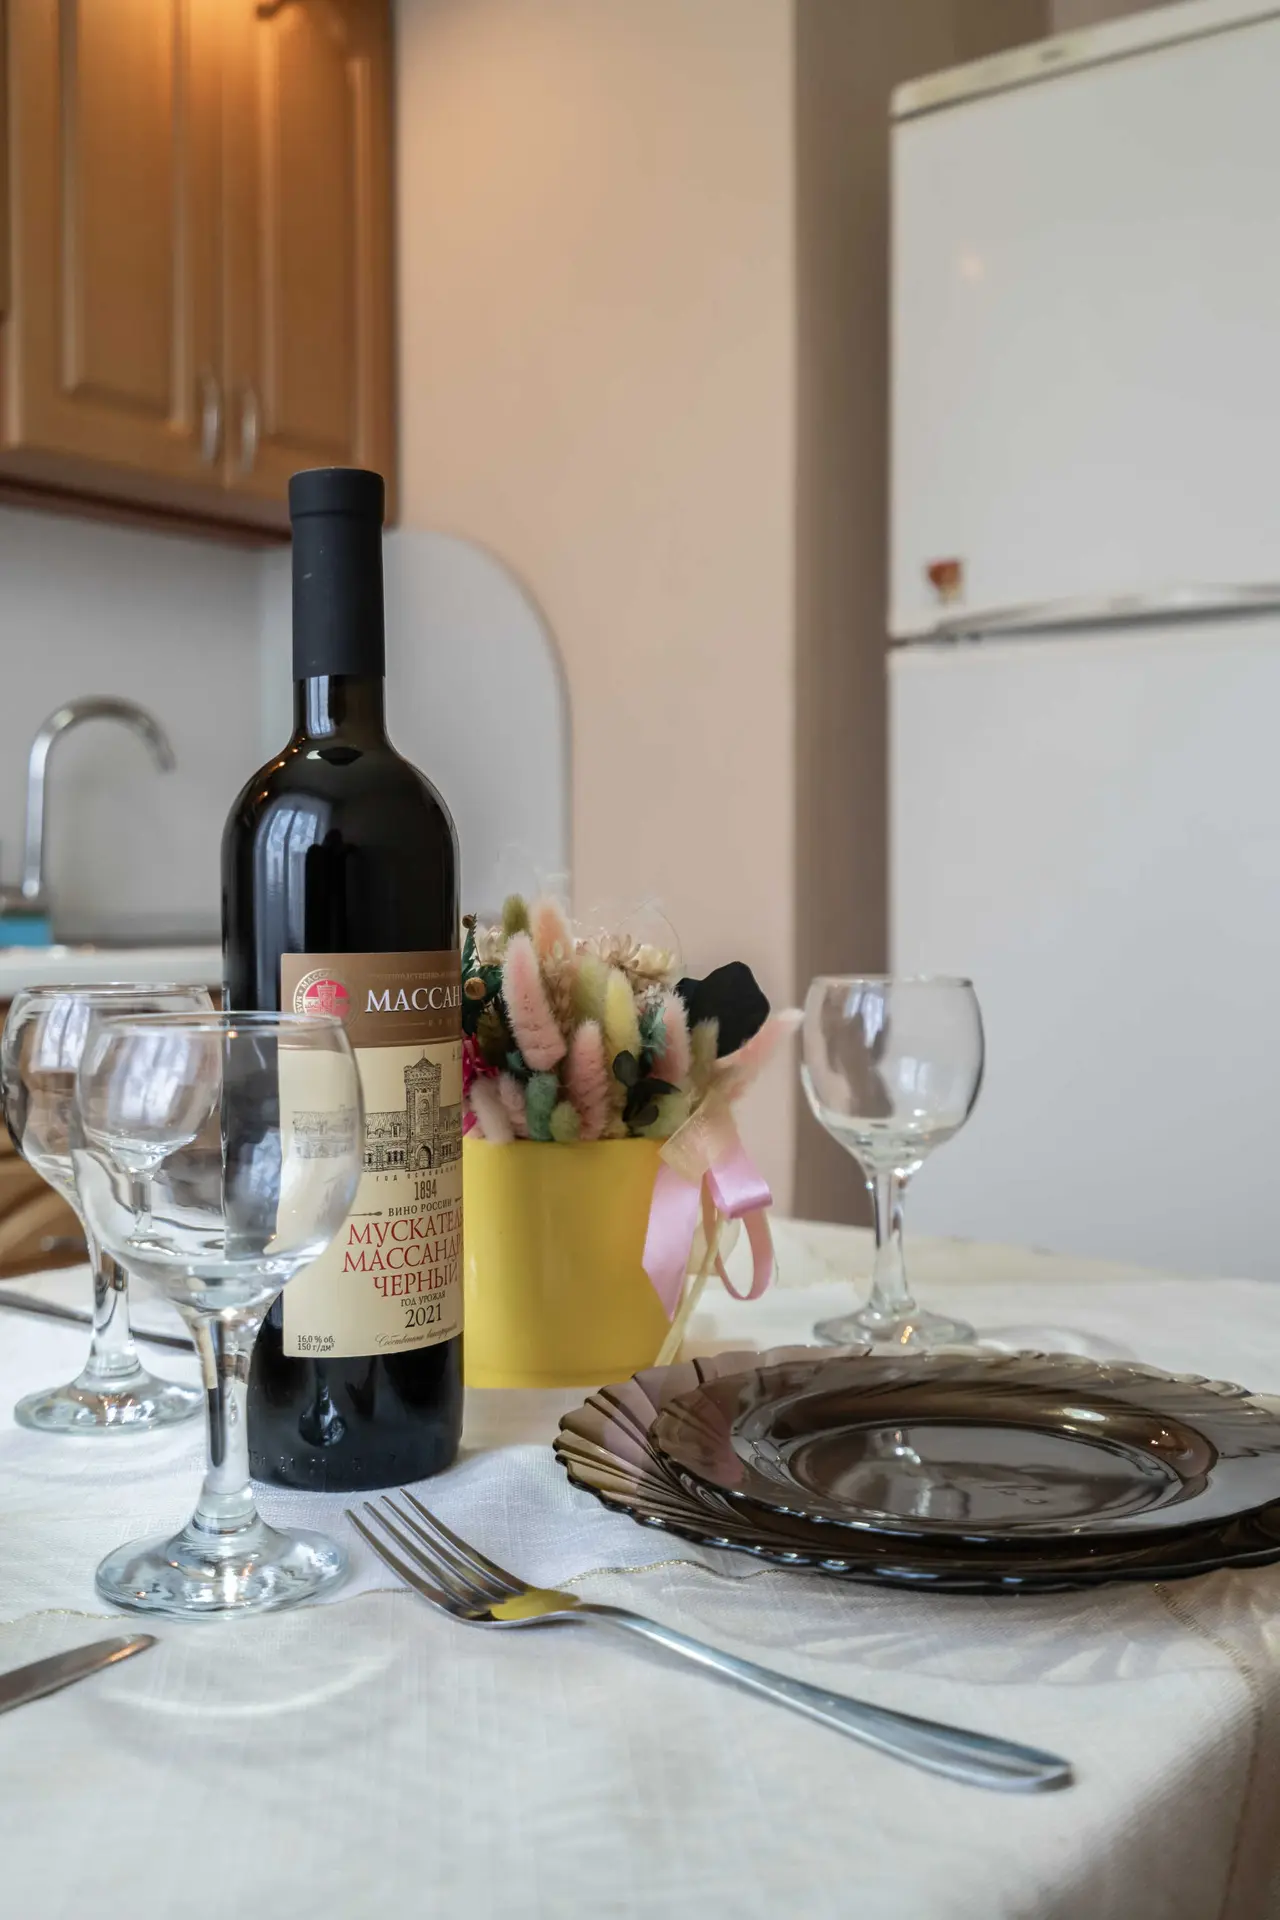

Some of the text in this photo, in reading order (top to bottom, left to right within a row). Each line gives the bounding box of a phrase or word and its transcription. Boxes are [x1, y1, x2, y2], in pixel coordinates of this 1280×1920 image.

[365, 985, 462, 1013] МАССАН
[376, 1174, 398, 1182] ГОД
[414, 1179, 437, 1201] 1894
[388, 1198, 452, 1217] ВИНО РОССИИ
[373, 1257, 458, 1298] ЧЕРНЫЙ
[405, 1303, 442, 1328] 2021
[297, 1334, 336, 1343] 16,0 % об.
[297, 1342, 311, 1351] 150
